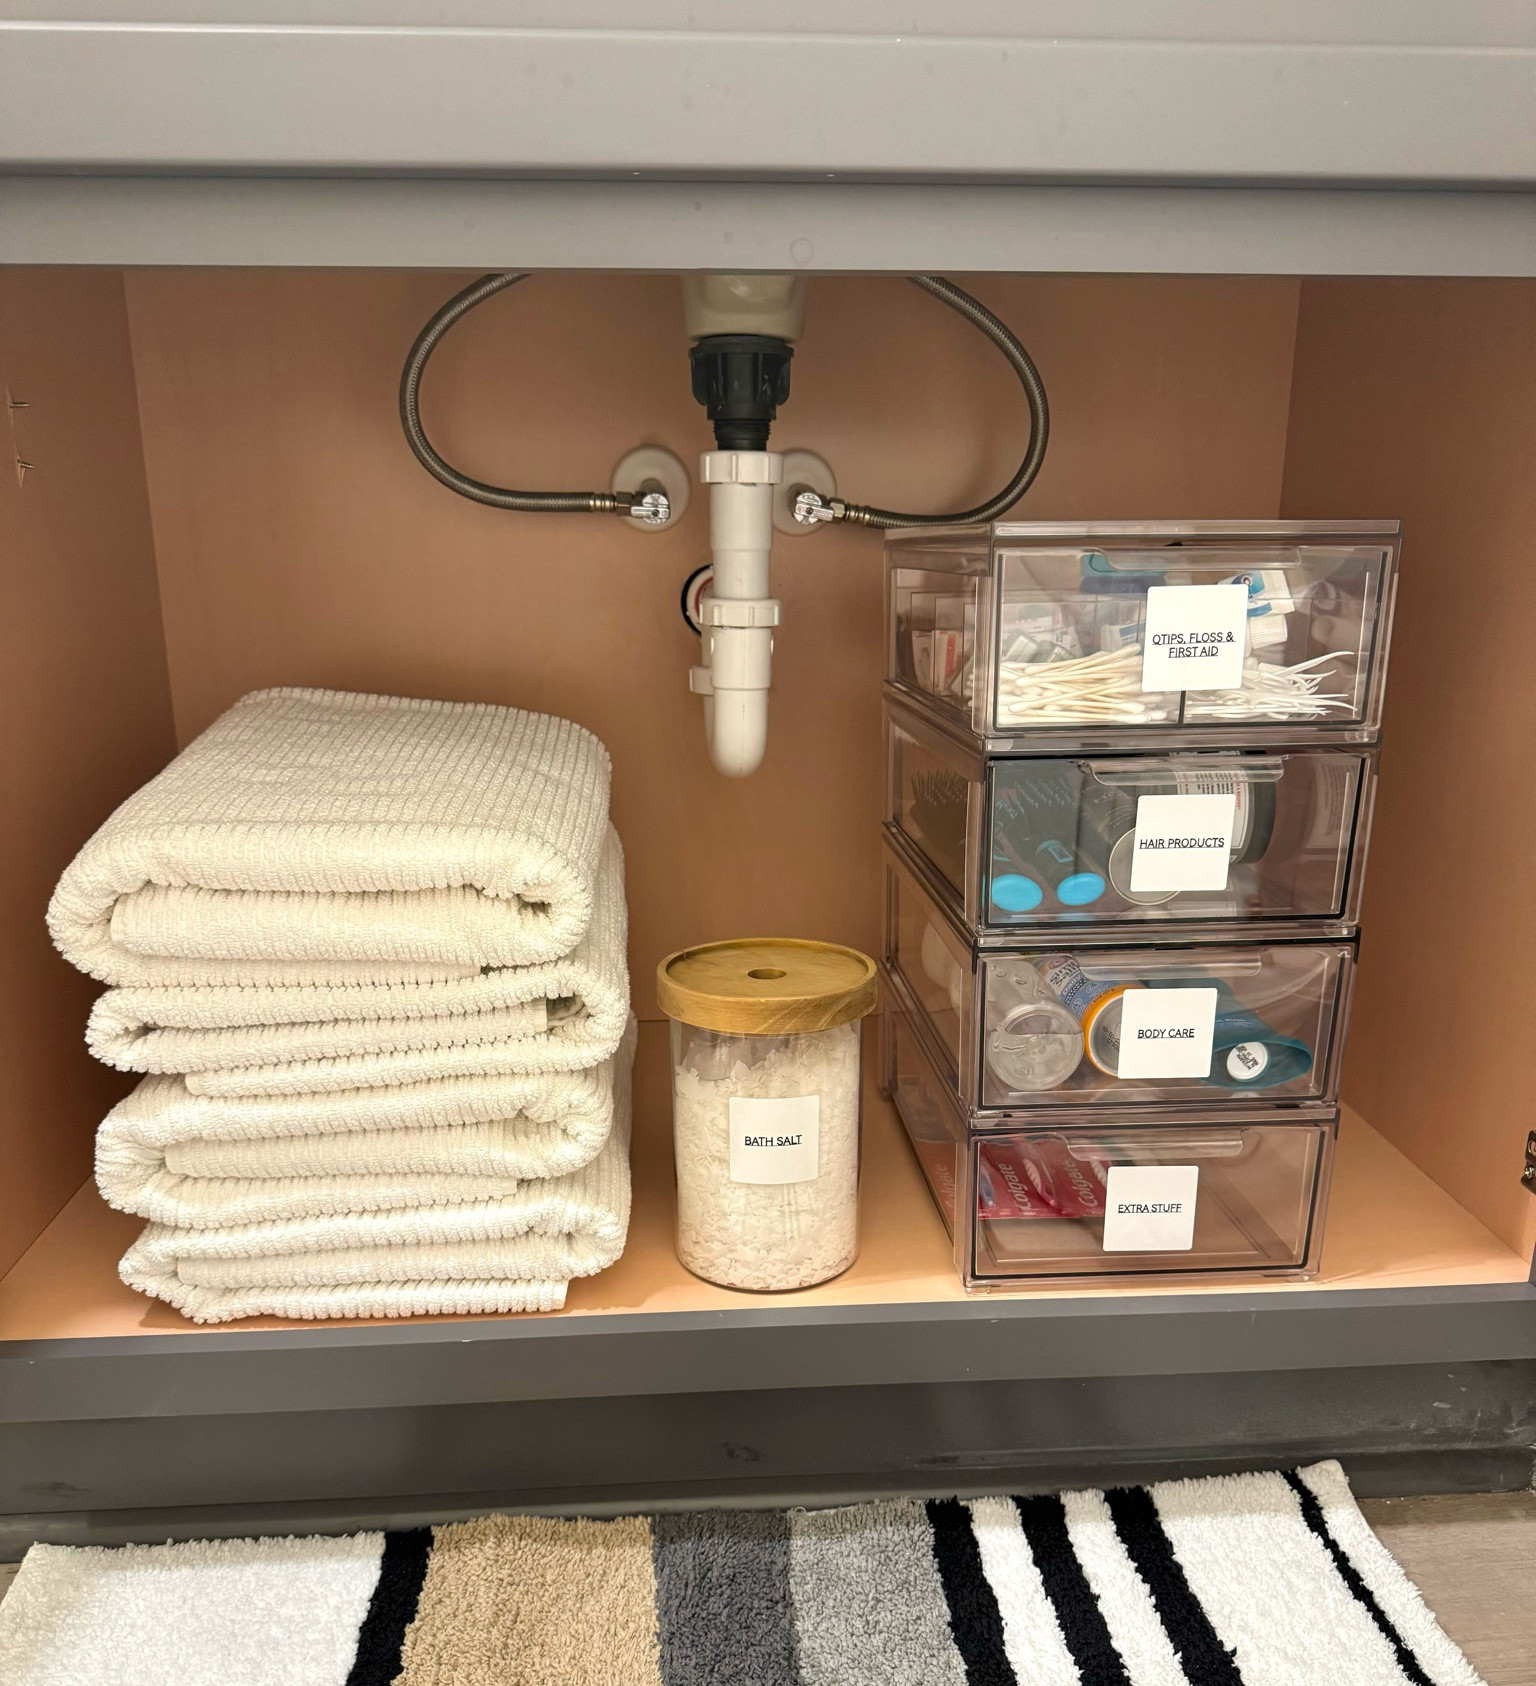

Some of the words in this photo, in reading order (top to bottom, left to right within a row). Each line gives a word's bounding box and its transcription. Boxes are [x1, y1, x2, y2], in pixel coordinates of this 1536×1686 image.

[1152, 633, 1187, 645] QTIPS,
[1189, 632, 1223, 643] FLOSS
[1225, 631, 1234, 642] &
[1168, 647, 1198, 658] FIRST
[1199, 646, 1219, 657] AID
[1139, 838, 1165, 849] HAIR
[1167, 837, 1225, 848] PRODUCTS
[1137, 1029, 1166, 1039] BODY
[1168, 1028, 1195, 1038] CARE
[744, 1136, 774, 1147] BATH
[776, 1134, 802, 1146] SALT
[999, 1163, 1032, 1212] Colgate
[1062, 1160, 1098, 1207] Colgate
[1118, 1204, 1149, 1213] EXTRA
[1151, 1203, 1182, 1213] STUFF
